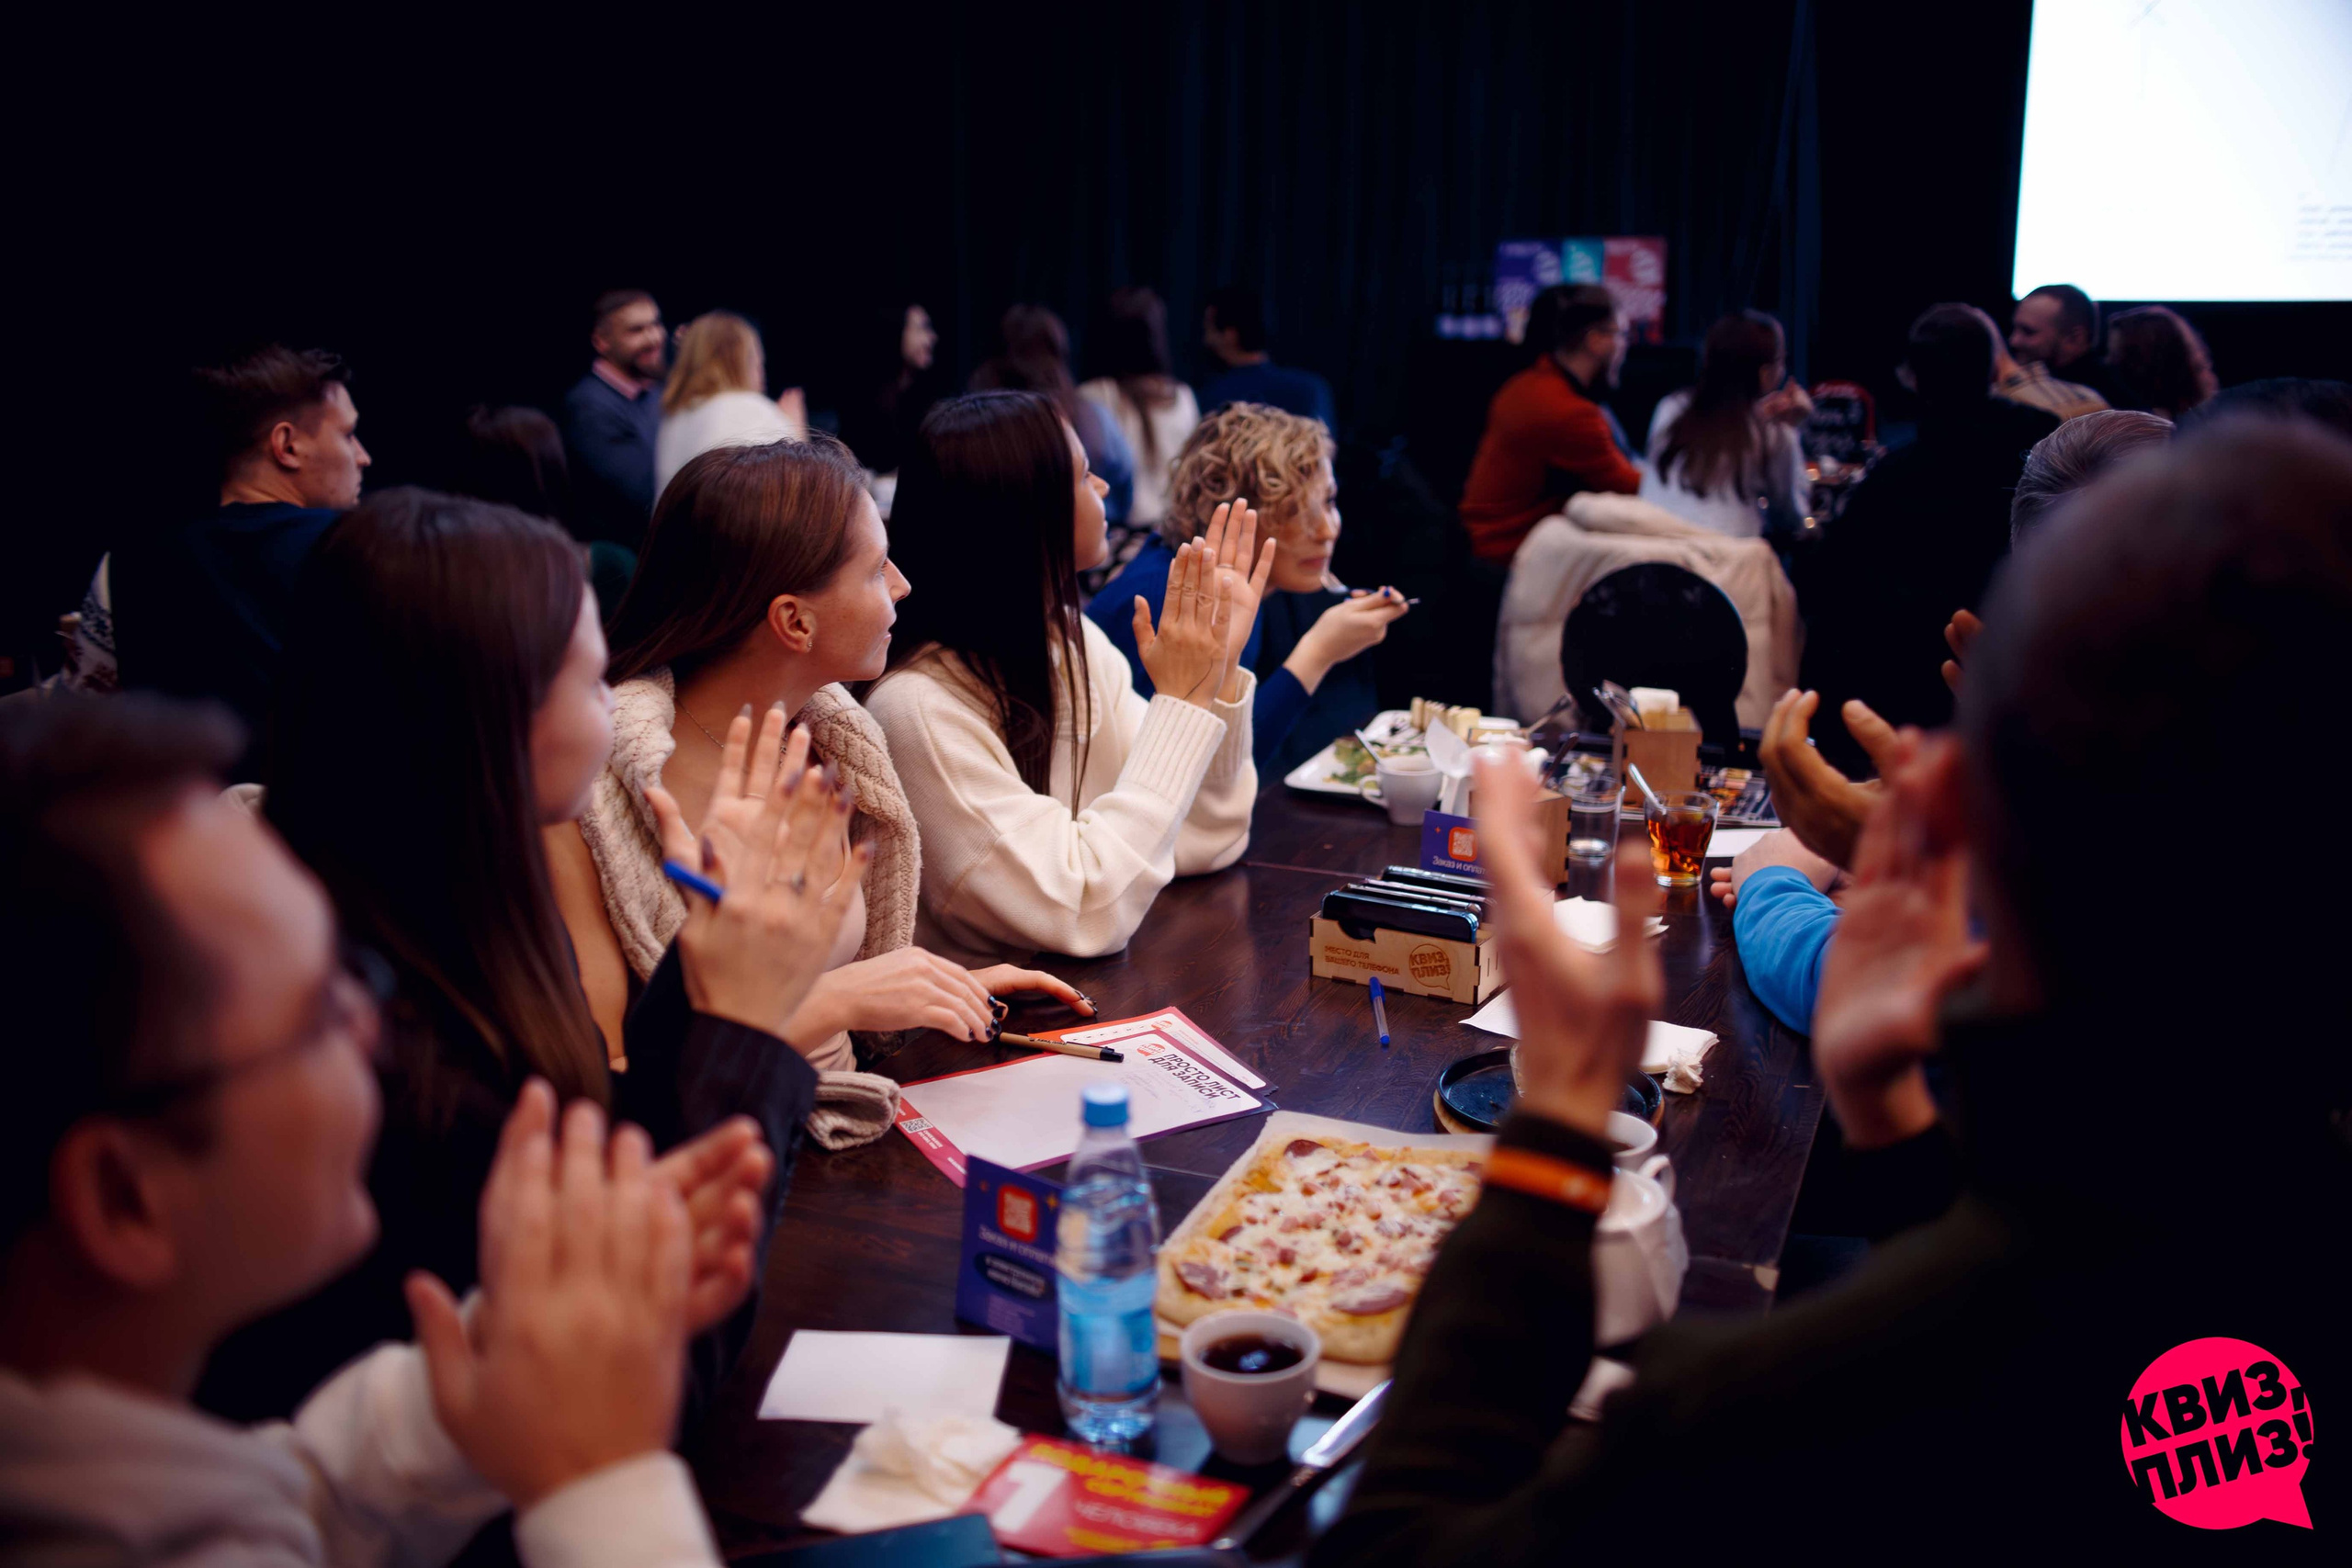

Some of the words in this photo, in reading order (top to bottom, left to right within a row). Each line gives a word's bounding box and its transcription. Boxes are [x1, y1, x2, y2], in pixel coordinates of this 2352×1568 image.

[1432, 855, 1456, 869] Заказ
[1456, 862, 1463, 870] и
[1463, 863, 1487, 874] оплат
[1325, 945, 1352, 957] МЕСТО
[1353, 950, 1370, 960] ДЛЯ
[1325, 955, 1357, 967] ВАШЕГО
[1358, 961, 1400, 975] ТЕЛЕФОНА
[1410, 964, 1451, 978] ПЛИЗ!
[1148, 1056, 1179, 1072] ДЛЯ
[1172, 1070, 1220, 1100] ЗАПИСИ
[1163, 1054, 1210, 1081] ПРОСТО
[1204, 1081, 1241, 1100] ЛИСТ
[991, 1461, 1067, 1534] 1
